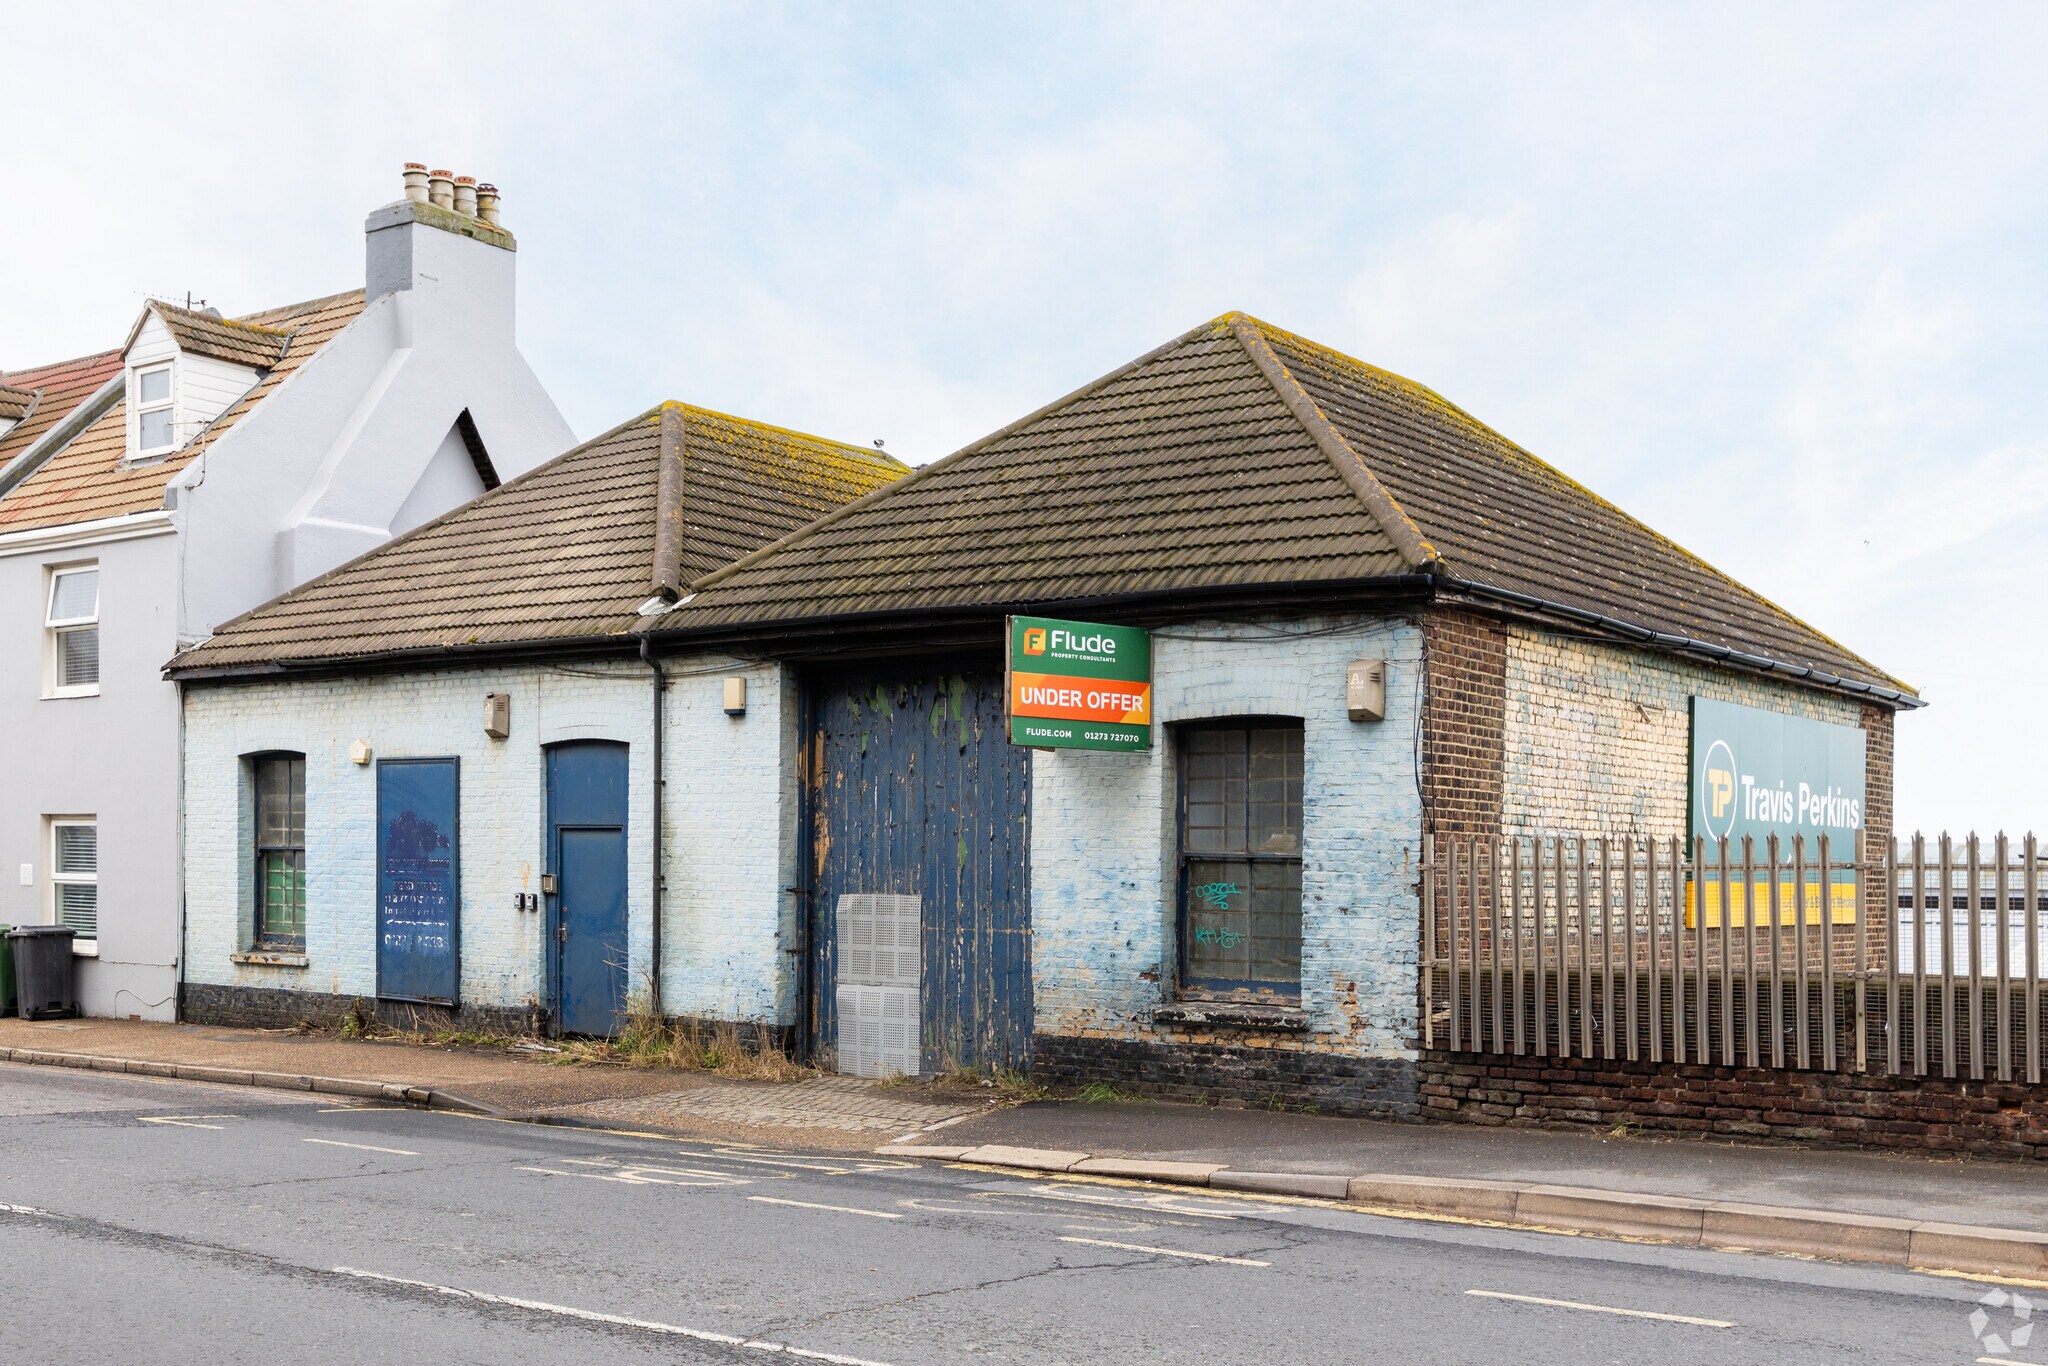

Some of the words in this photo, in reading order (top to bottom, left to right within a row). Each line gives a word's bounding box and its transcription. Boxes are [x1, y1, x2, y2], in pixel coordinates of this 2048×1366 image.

[1051, 630, 1116, 654] Flude
[1051, 652, 1078, 660] PROPERTY
[1079, 655, 1116, 663] CONSULTANTS
[1021, 686, 1083, 708] UNDER
[1087, 691, 1144, 713] OFFER
[1026, 727, 1072, 738] FLUDE.COM
[1084, 732, 1108, 741] 01273
[1110, 733, 1139, 743] 727070
[1708, 768, 1733, 818] TP
[1741, 775, 1794, 824] Travis
[1798, 782, 1859, 830] Perkins
